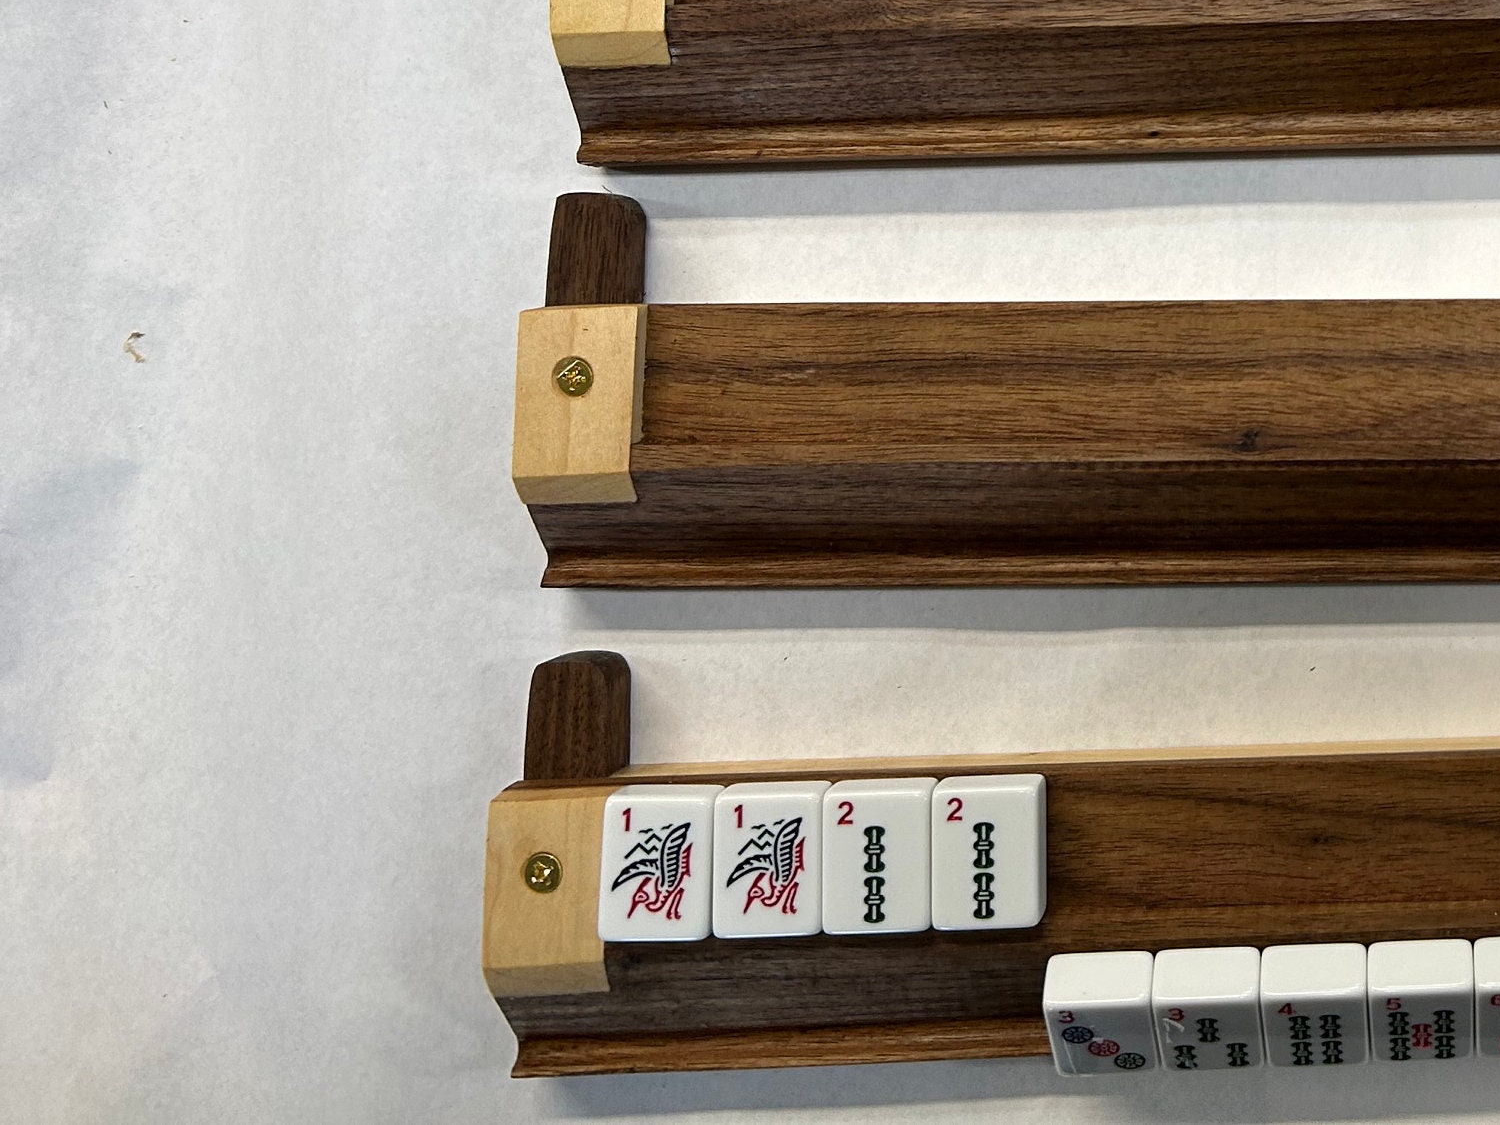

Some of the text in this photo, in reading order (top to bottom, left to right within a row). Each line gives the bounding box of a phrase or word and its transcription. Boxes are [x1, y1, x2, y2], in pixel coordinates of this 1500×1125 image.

[621, 808, 632, 832] 1
[732, 805, 744, 829] 1
[837, 800, 854, 825] 2
[946, 798, 963, 823] 2
[1277, 1003, 1296, 1016] 4
[1385, 996, 1402, 1012] 5
[1059, 1010, 1075, 1024] 3
[1168, 1007, 1185, 1022] 3
